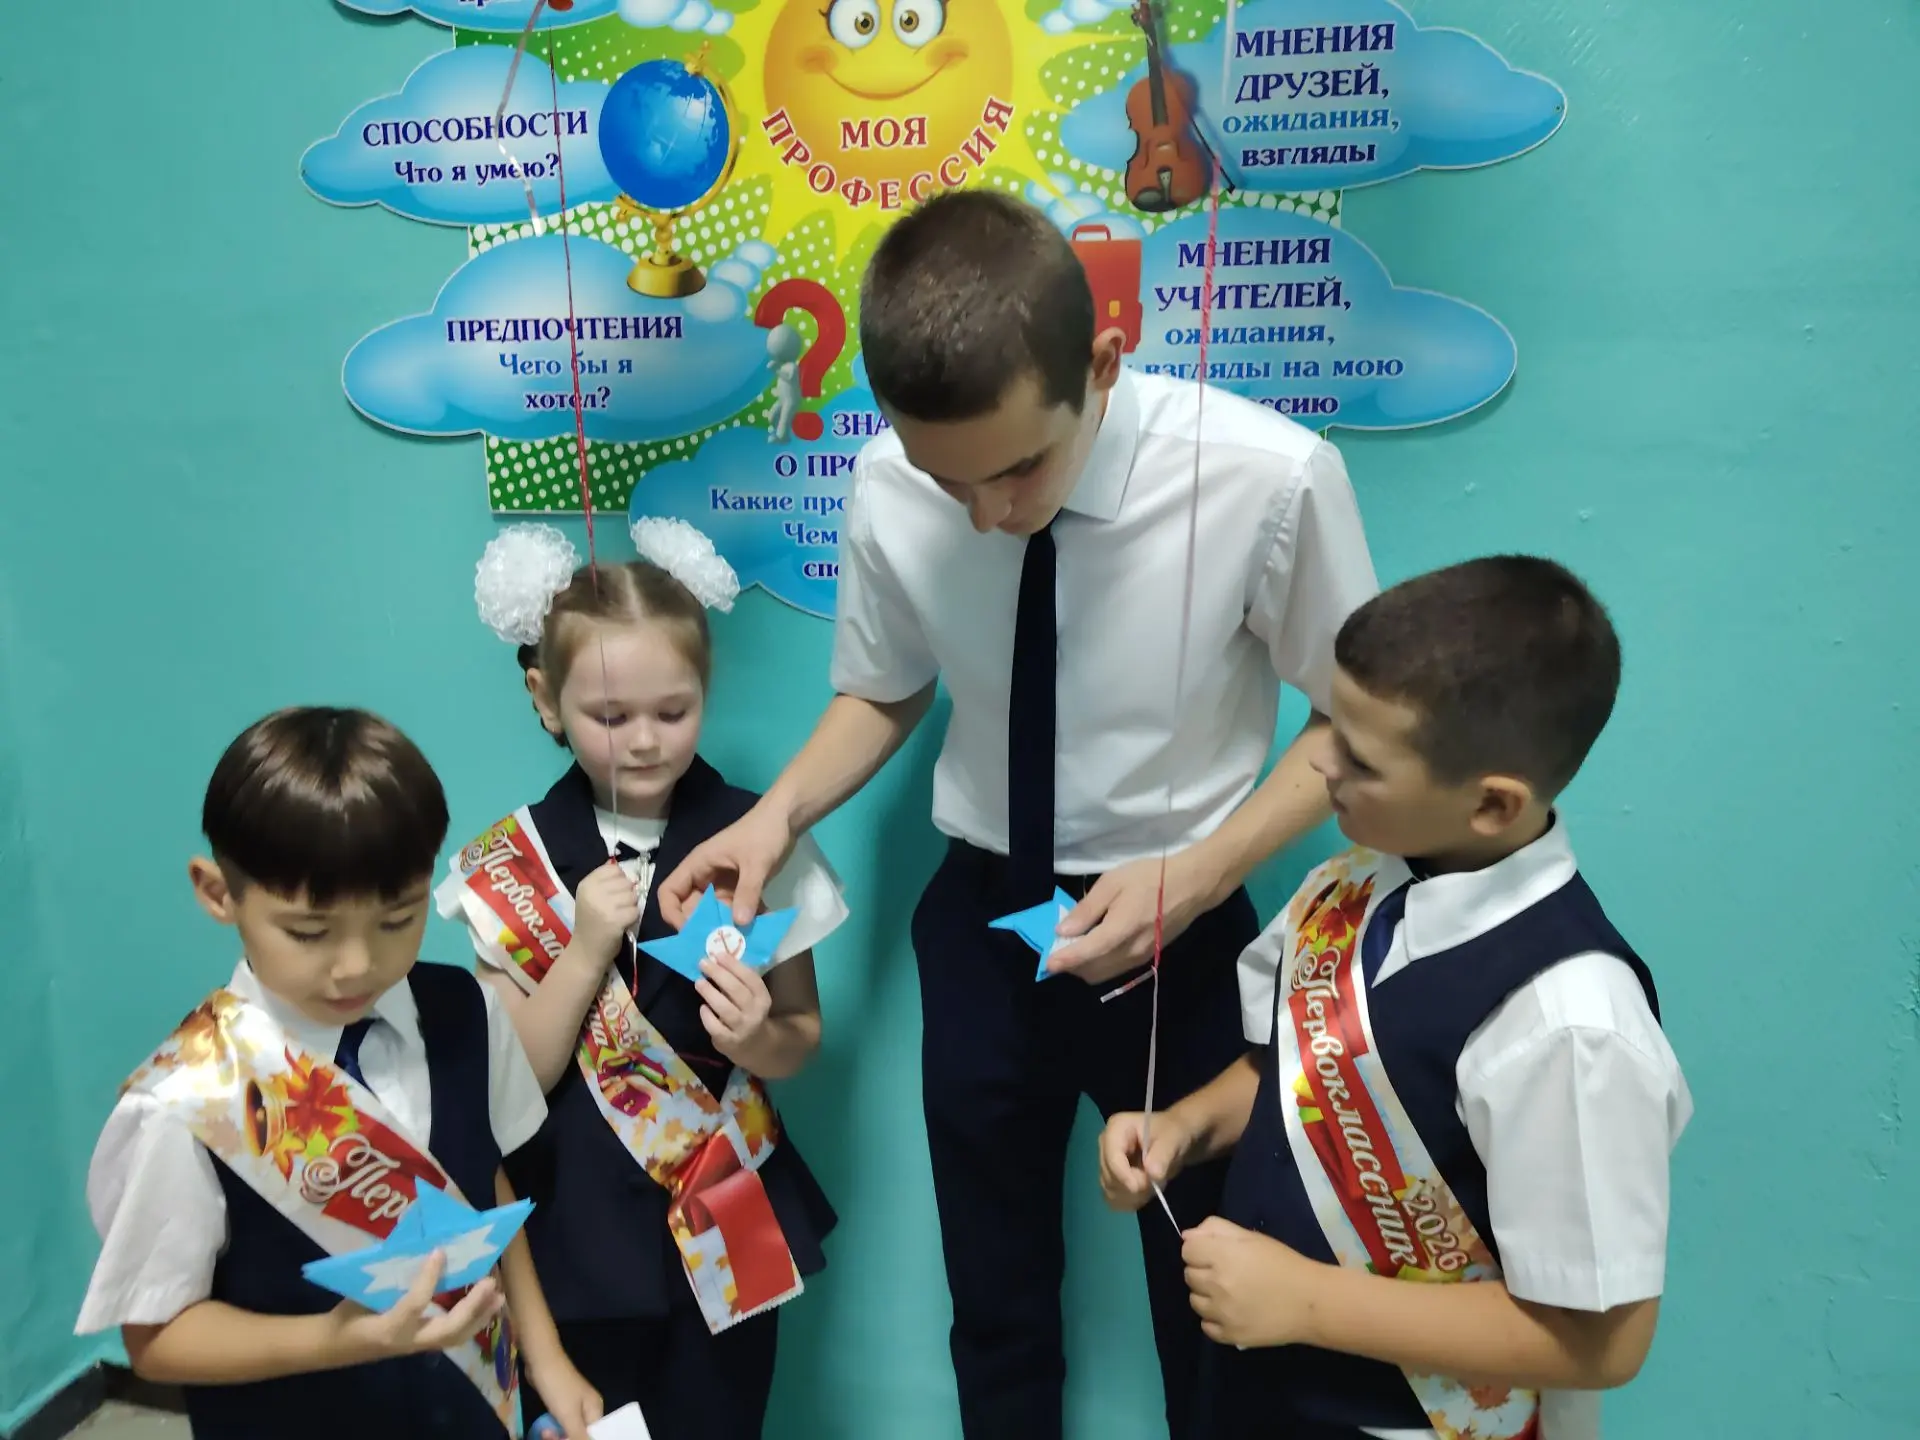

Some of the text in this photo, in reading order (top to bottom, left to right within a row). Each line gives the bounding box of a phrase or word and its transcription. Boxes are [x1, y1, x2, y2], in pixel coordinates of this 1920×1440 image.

[1236, 23, 1395, 58] МНЕНИЯ
[1235, 63, 1390, 105] ДРУЗЕЙ,
[363, 110, 588, 146] СПОСОБНОСТИ
[841, 117, 927, 148] МОЯ
[1223, 108, 1401, 133] ожидания,
[762, 97, 1014, 210] ПРОФЕССИЯ
[1241, 143, 1376, 168] взгляды
[395, 153, 559, 186] Что я умею?
[1178, 238, 1331, 267] МНЕНИЯ
[1154, 276, 1352, 312] УЧИТЕЛЕЙ,
[447, 316, 683, 343] ПРЕДПОЧТЕНИЯ
[1165, 325, 1335, 346] ожидания,
[499, 353, 562, 375] Чего
[618, 359, 632, 374] я
[1283, 361, 1320, 377] на
[1332, 358, 1404, 376] мою
[832, 412, 891, 437] ЗНА
[775, 454, 798, 477] О
[711, 488, 793, 511] Какие
[784, 522, 838, 544] Чем
[1292, 945, 1418, 1267] Первоклассник
[1402, 1197, 1469, 1272] 2026
